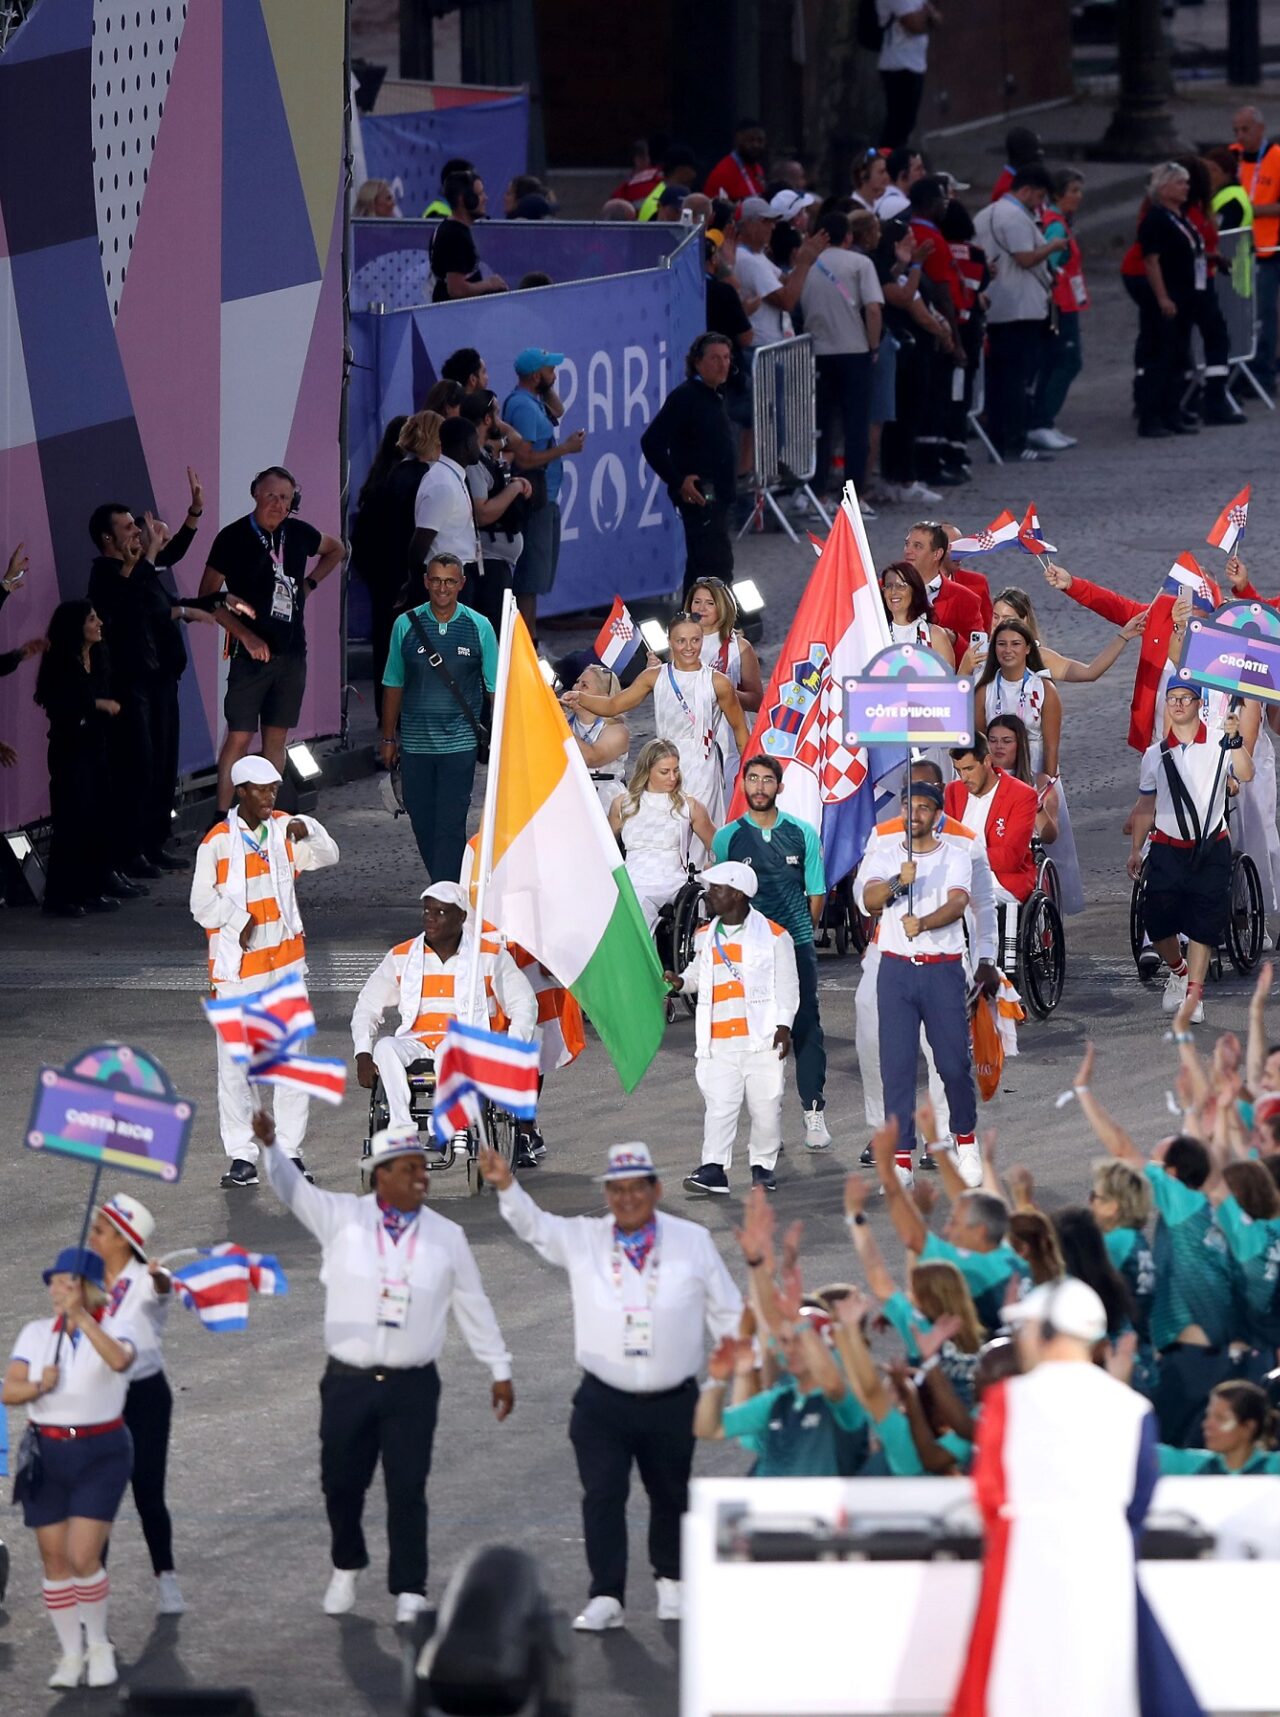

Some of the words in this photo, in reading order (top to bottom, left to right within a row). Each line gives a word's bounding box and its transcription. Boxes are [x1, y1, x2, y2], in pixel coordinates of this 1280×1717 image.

[559, 452, 665, 542] 202
[1218, 653, 1269, 675] CROATIE
[865, 703, 898, 719] CÔTE
[899, 706, 951, 719] D'IVOIRE
[65, 1107, 116, 1134] COSTA
[116, 1120, 155, 1143] RICA
